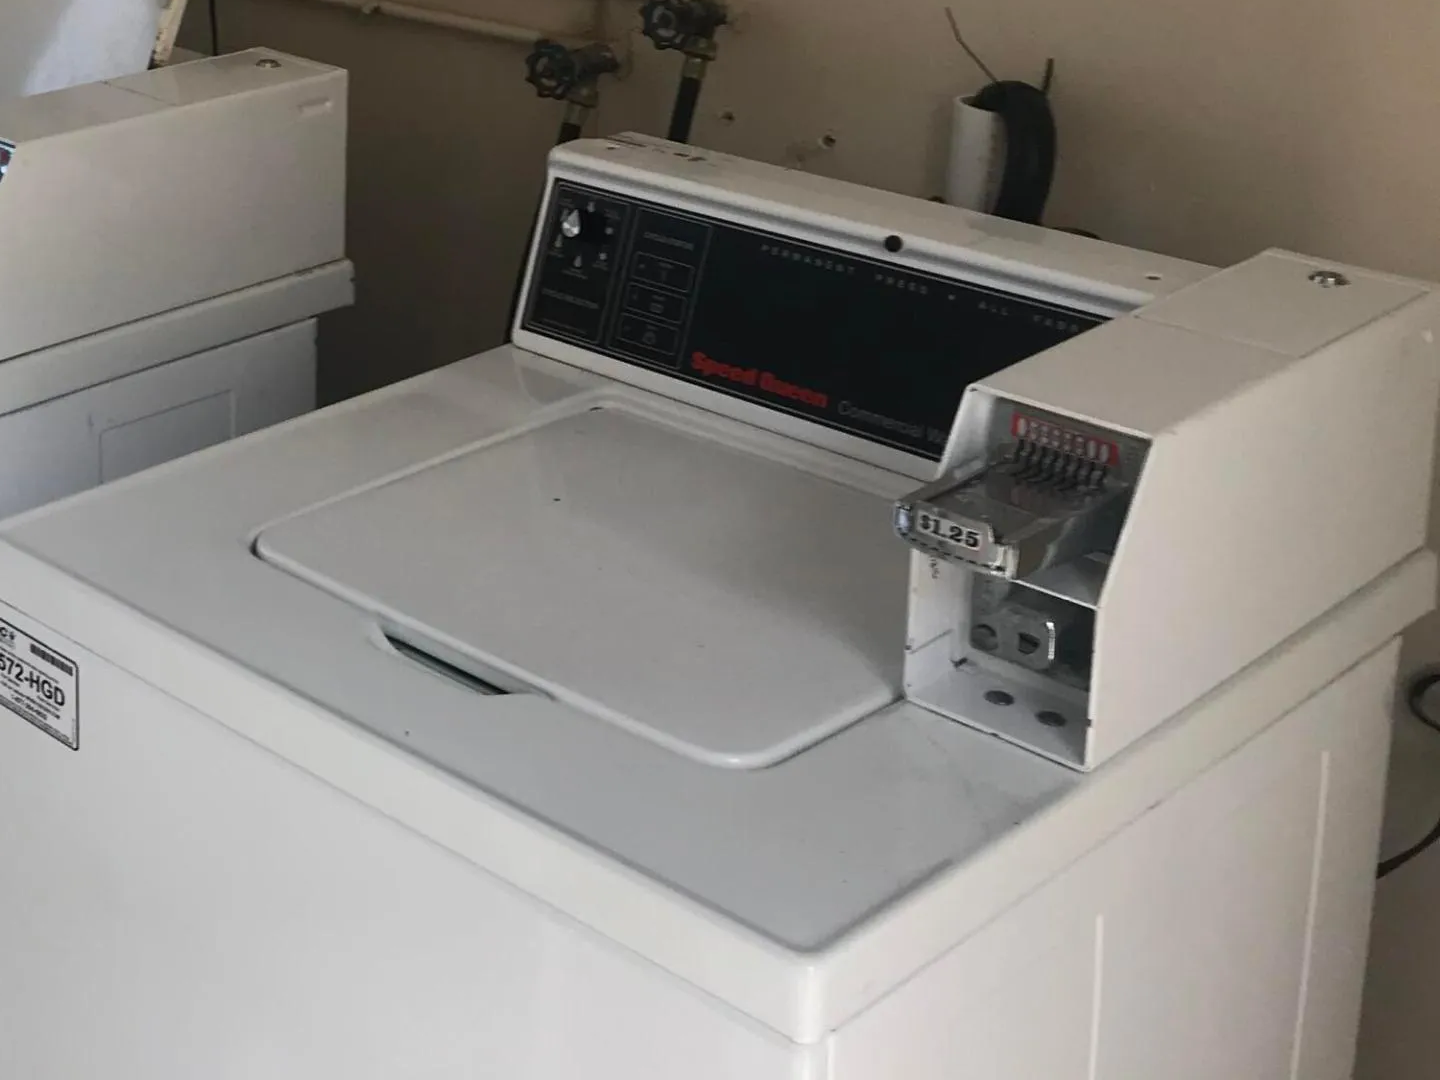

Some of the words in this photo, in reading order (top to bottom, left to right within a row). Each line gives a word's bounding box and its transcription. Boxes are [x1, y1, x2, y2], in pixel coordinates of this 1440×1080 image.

[691, 351, 758, 386] Speed
[759, 371, 829, 409] Queen
[921, 514, 979, 548] $1.25
